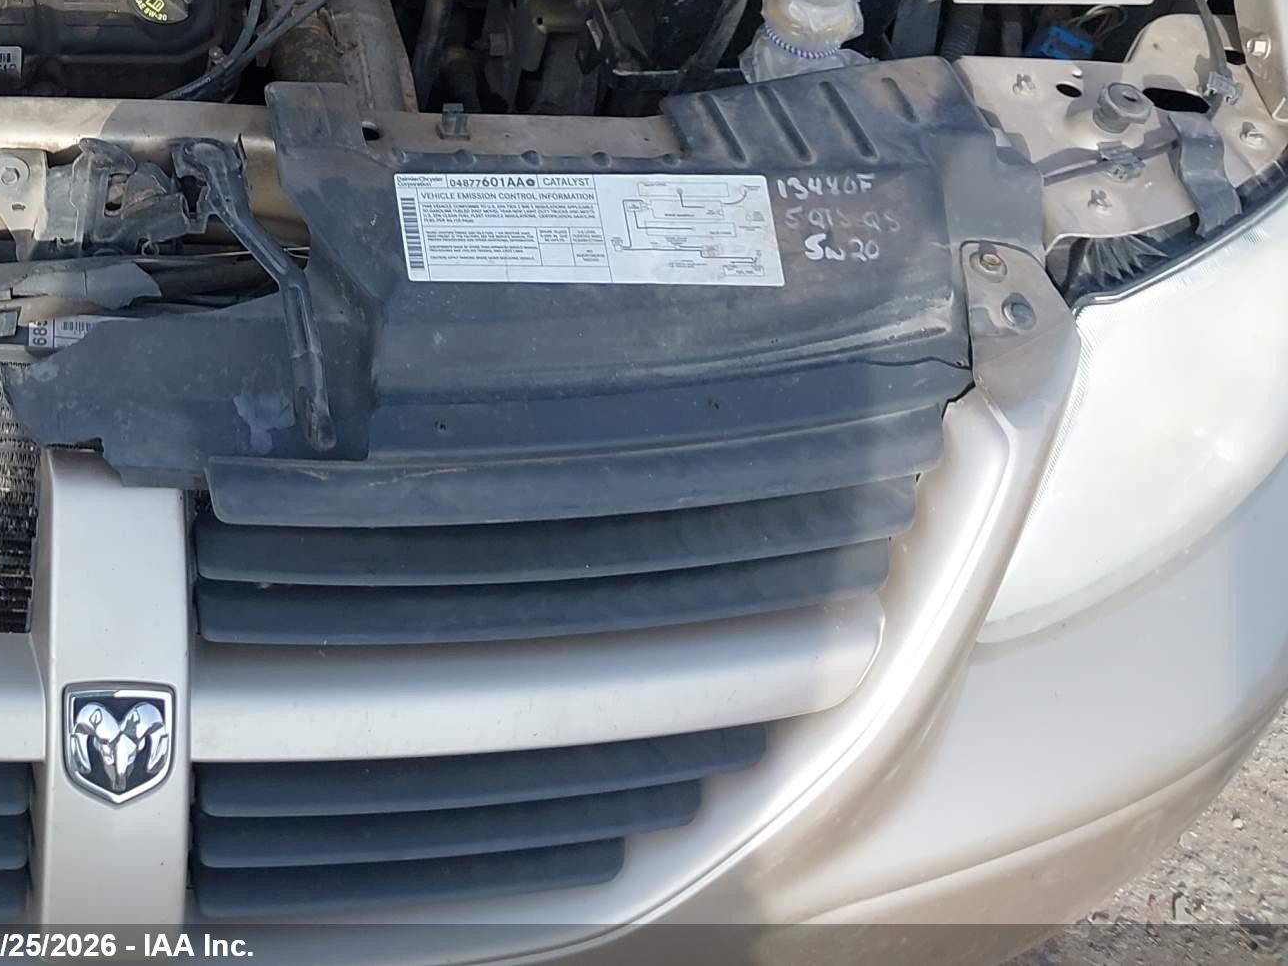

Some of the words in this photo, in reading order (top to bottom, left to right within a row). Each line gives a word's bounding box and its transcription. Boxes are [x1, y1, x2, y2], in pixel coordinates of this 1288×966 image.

[542, 178, 590, 187] CATALYST
[420, 192, 456, 200] VEHICLE
[457, 192, 497, 200] EMISSION
[499, 192, 537, 200] CONTROL
[539, 192, 595, 200] INFORMATION
